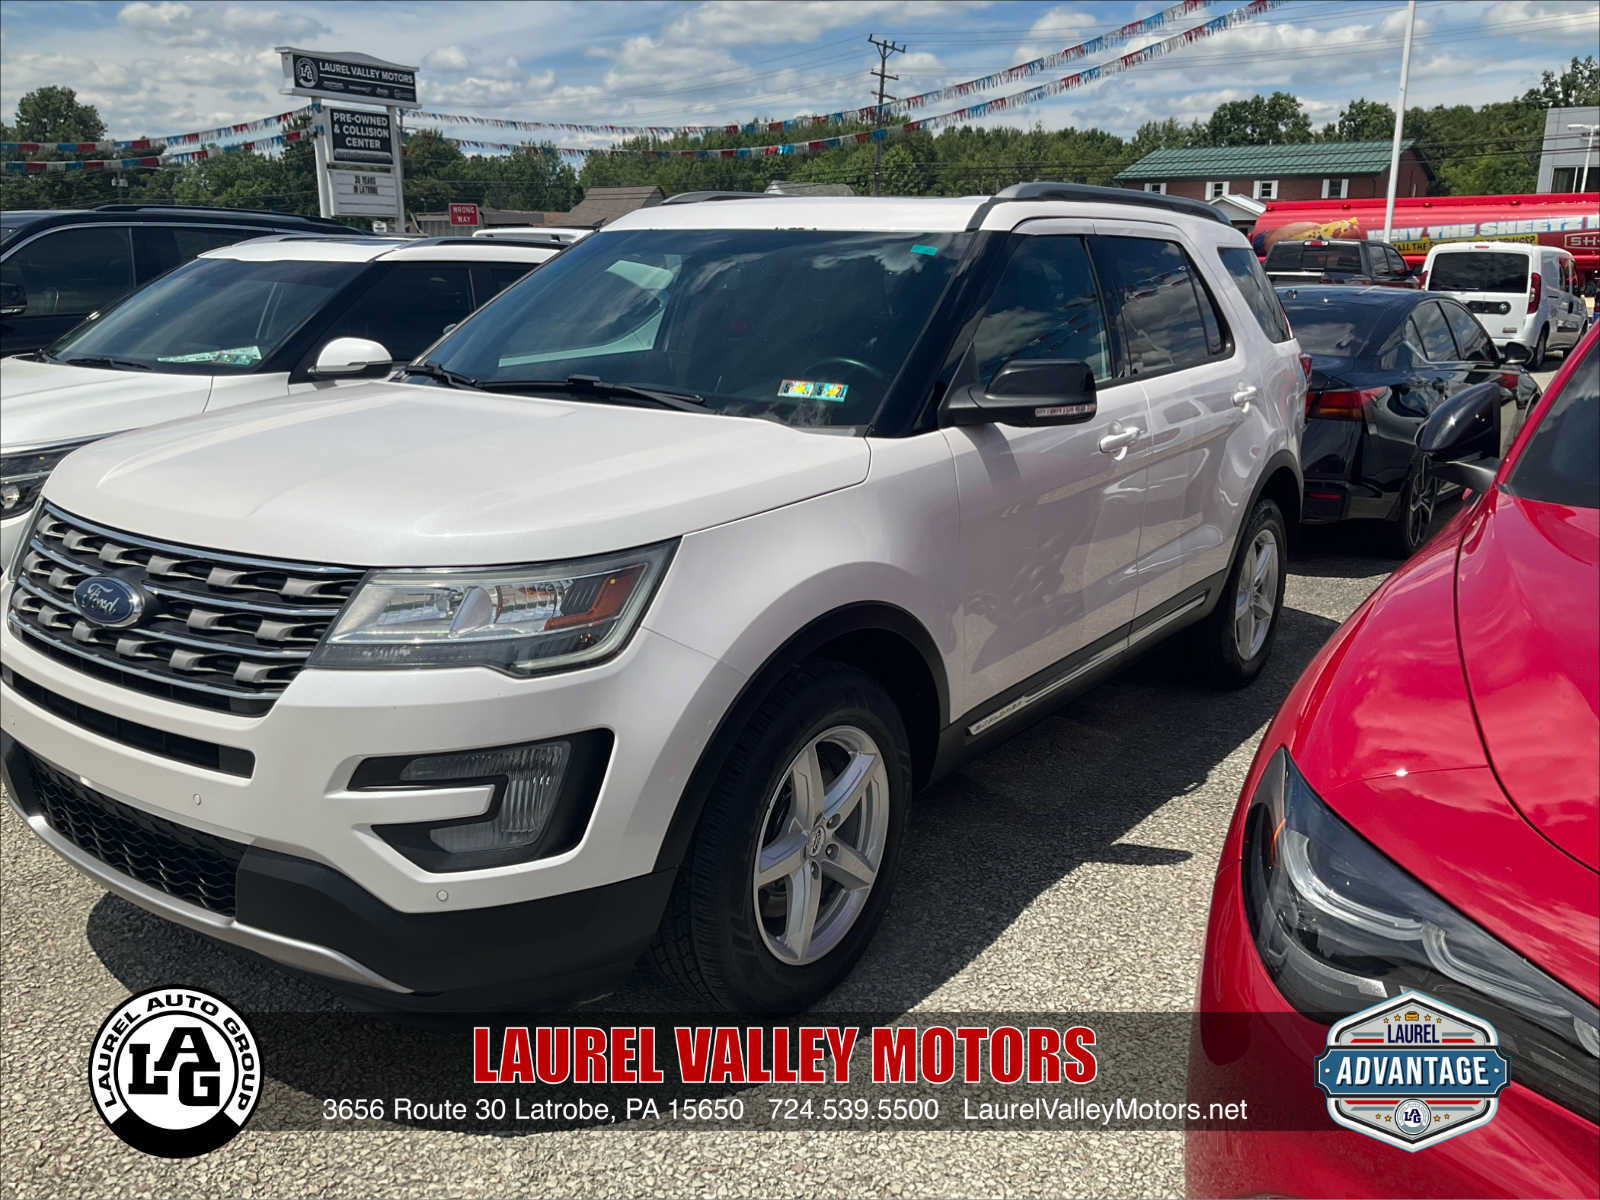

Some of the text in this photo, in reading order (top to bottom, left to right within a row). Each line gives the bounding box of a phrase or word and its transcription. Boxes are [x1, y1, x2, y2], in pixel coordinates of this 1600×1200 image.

[319, 62, 413, 84] LAUREL VALLEY MOTORS
[333, 112, 388, 126] PRE-OWNED
[334, 124, 390, 138] & COLLISION
[345, 137, 381, 149] CENTER
[453, 206, 475, 214] WRONG
[1427, 222, 1477, 240] THE
[81, 583, 121, 615] Ford
